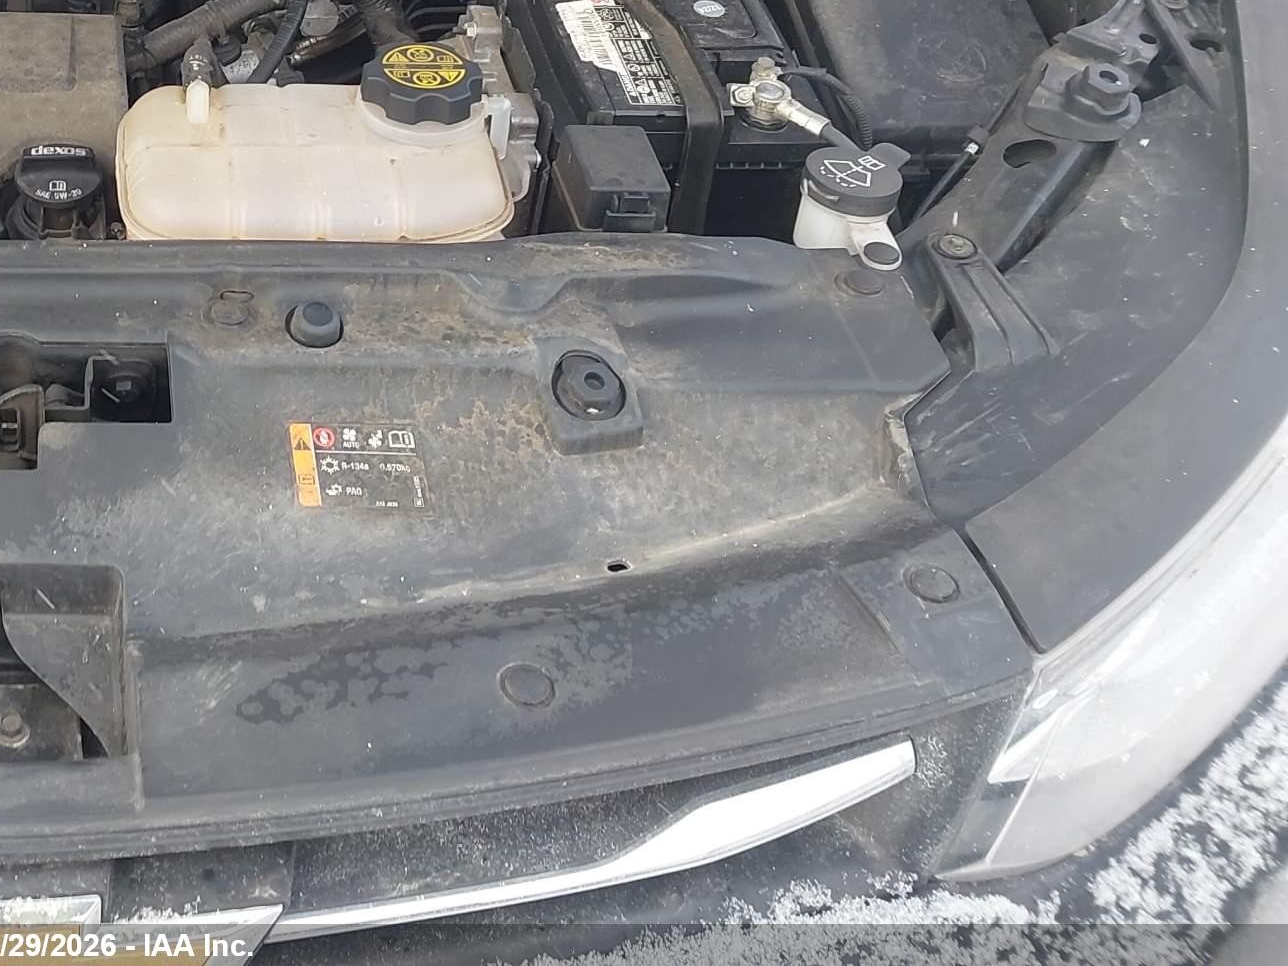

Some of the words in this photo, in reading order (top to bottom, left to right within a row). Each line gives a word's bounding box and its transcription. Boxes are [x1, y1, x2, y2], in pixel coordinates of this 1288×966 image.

[30, 145, 87, 156] dexos
[34, 188, 51, 199] SAE
[341, 462, 369, 470] R-134a
